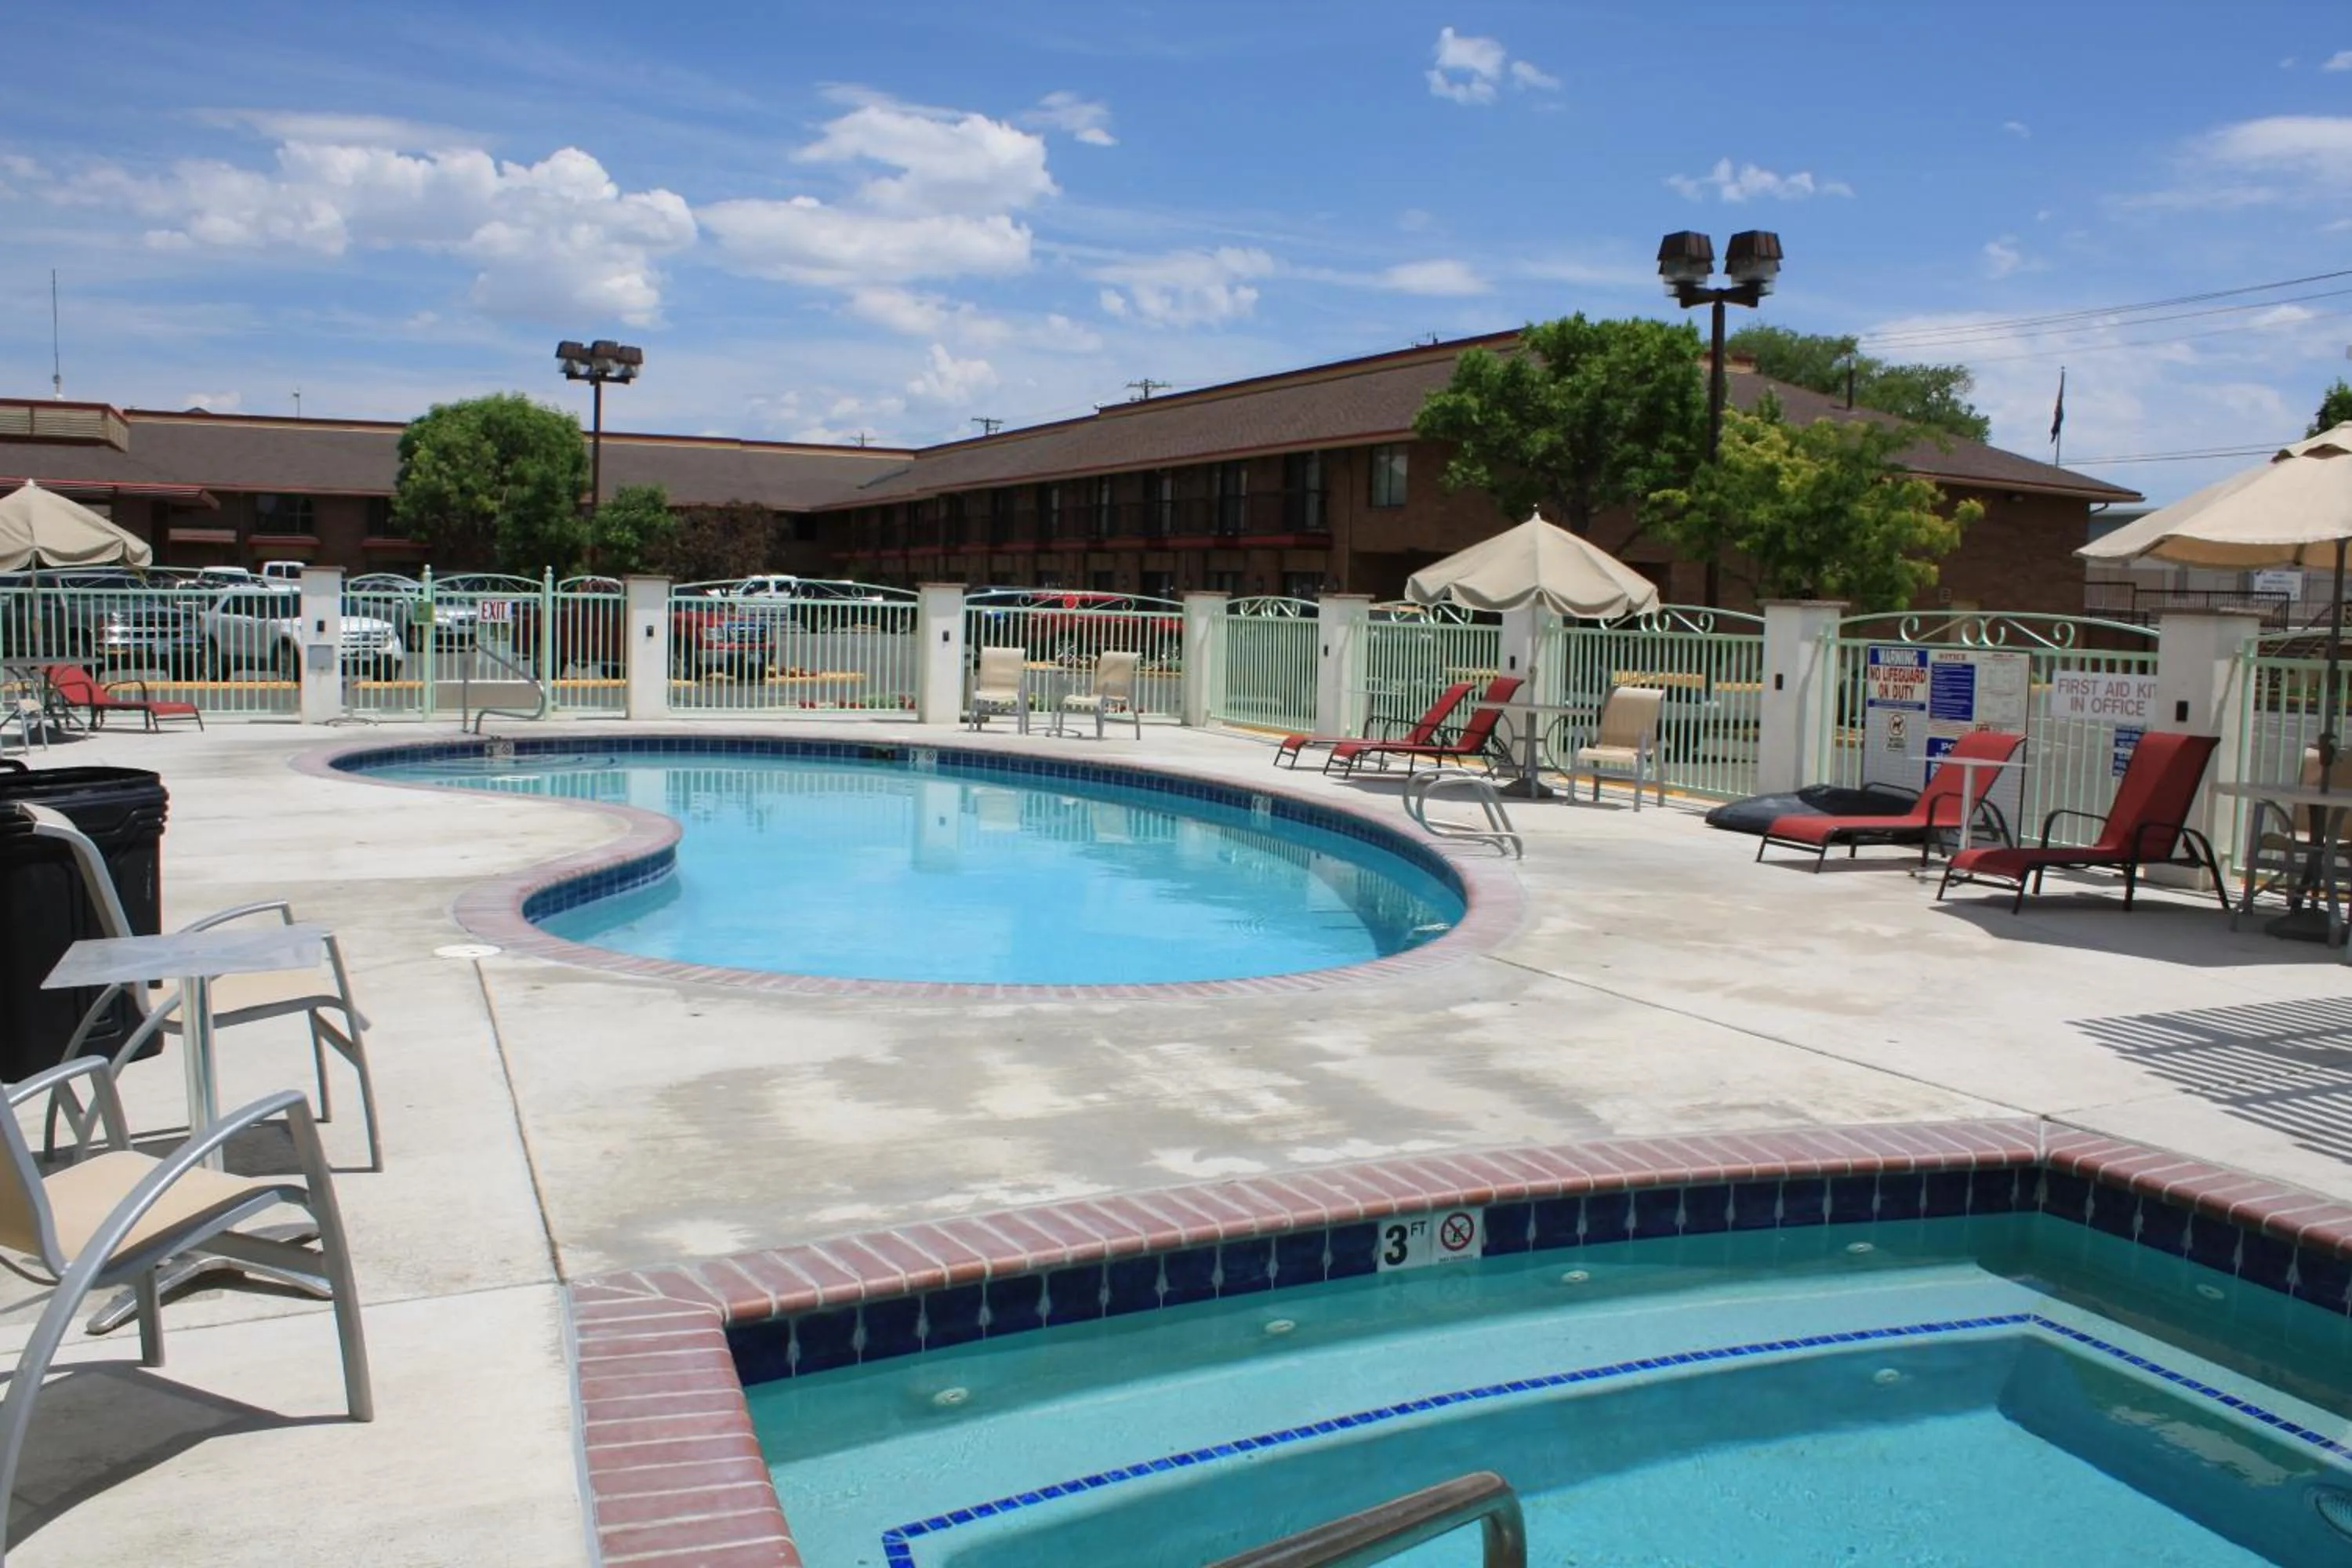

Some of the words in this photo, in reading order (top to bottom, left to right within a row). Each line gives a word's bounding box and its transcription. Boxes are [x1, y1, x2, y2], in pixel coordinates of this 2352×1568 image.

[482, 601, 506, 619] EXIT
[1878, 649, 1917, 666] WARNING
[1870, 666, 1881, 681] NO
[1882, 667, 1926, 684] LIFEGUARD
[1878, 682, 1889, 698] ON
[1893, 684, 1915, 699] DUTY
[2057, 678, 2102, 695] FIRST
[2105, 681, 2130, 698] AID
[2070, 696, 2085, 713] IN
[2090, 697, 2146, 717] OFFICE
[1384, 1224, 1408, 1265] 3
[1410, 1220, 1427, 1237] FT
